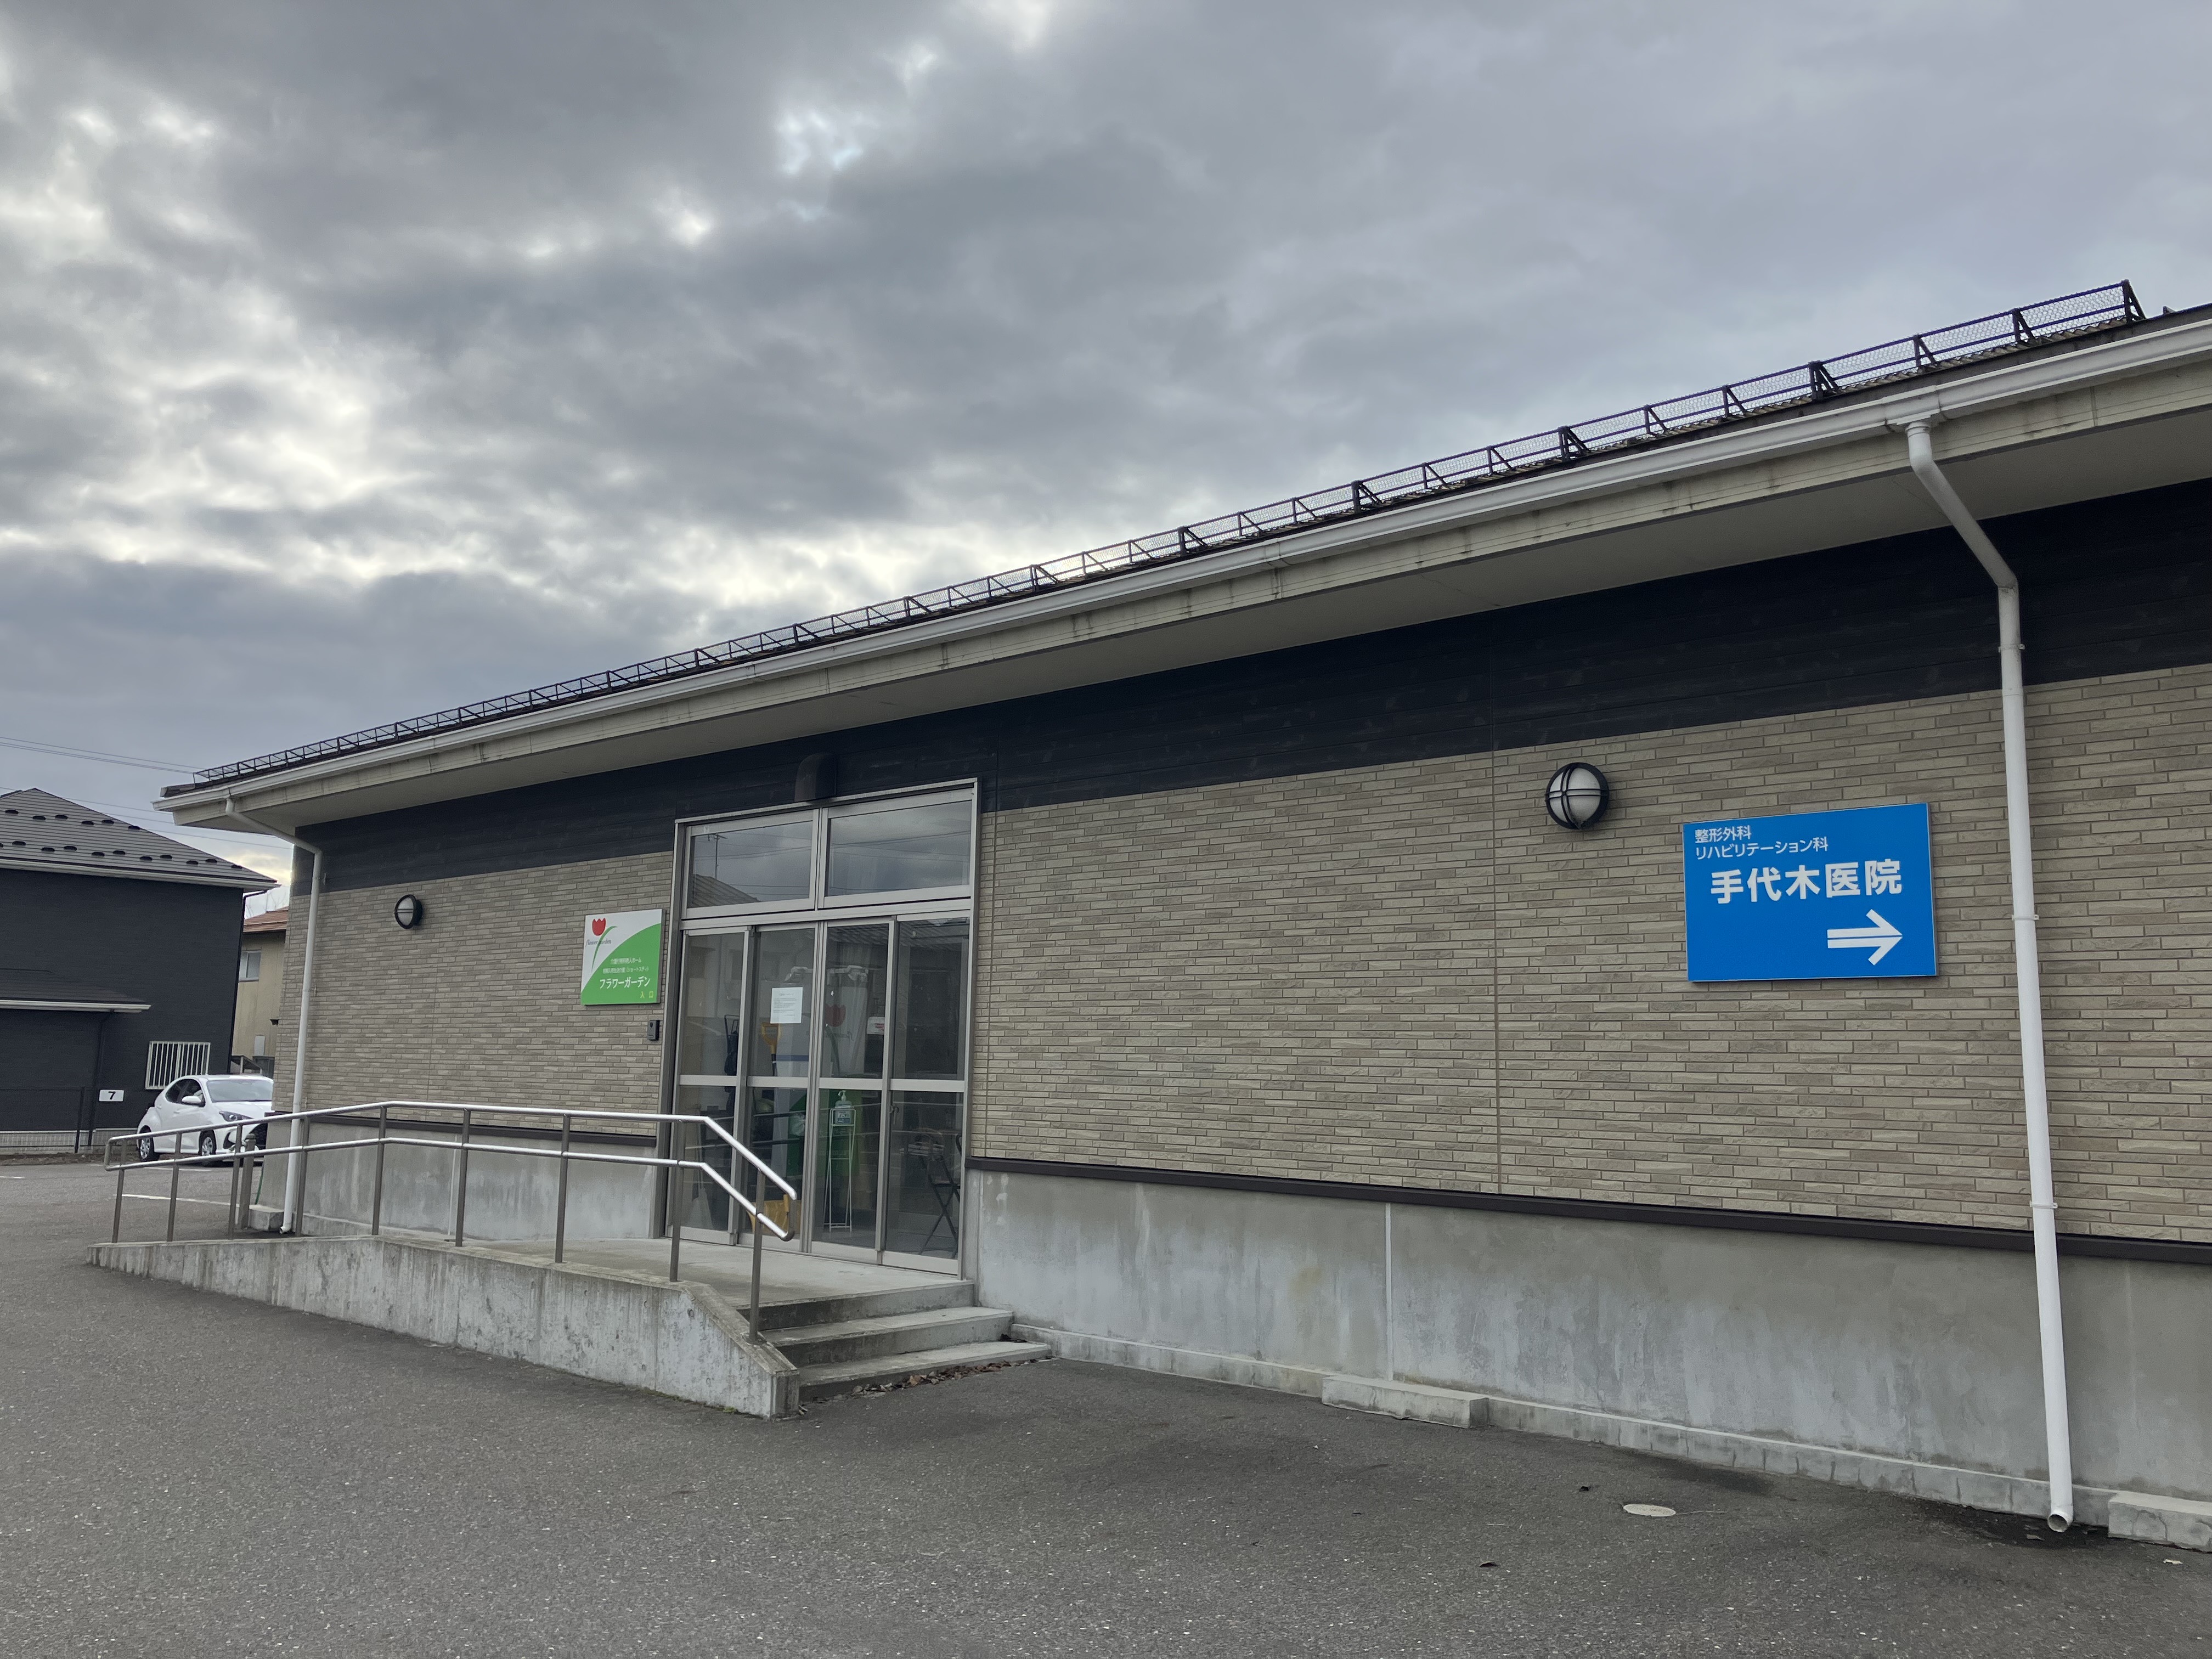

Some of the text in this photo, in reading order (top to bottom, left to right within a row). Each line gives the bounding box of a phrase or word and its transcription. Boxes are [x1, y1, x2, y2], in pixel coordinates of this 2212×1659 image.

[1695, 825, 1751, 843] 整形外科
[1696, 837, 1829, 860] リハビリテーション科
[1711, 859, 1902, 904] 手代木医院
[600, 976, 650, 989] フラワーガーデン
[108, 1091, 116, 1100] 7
